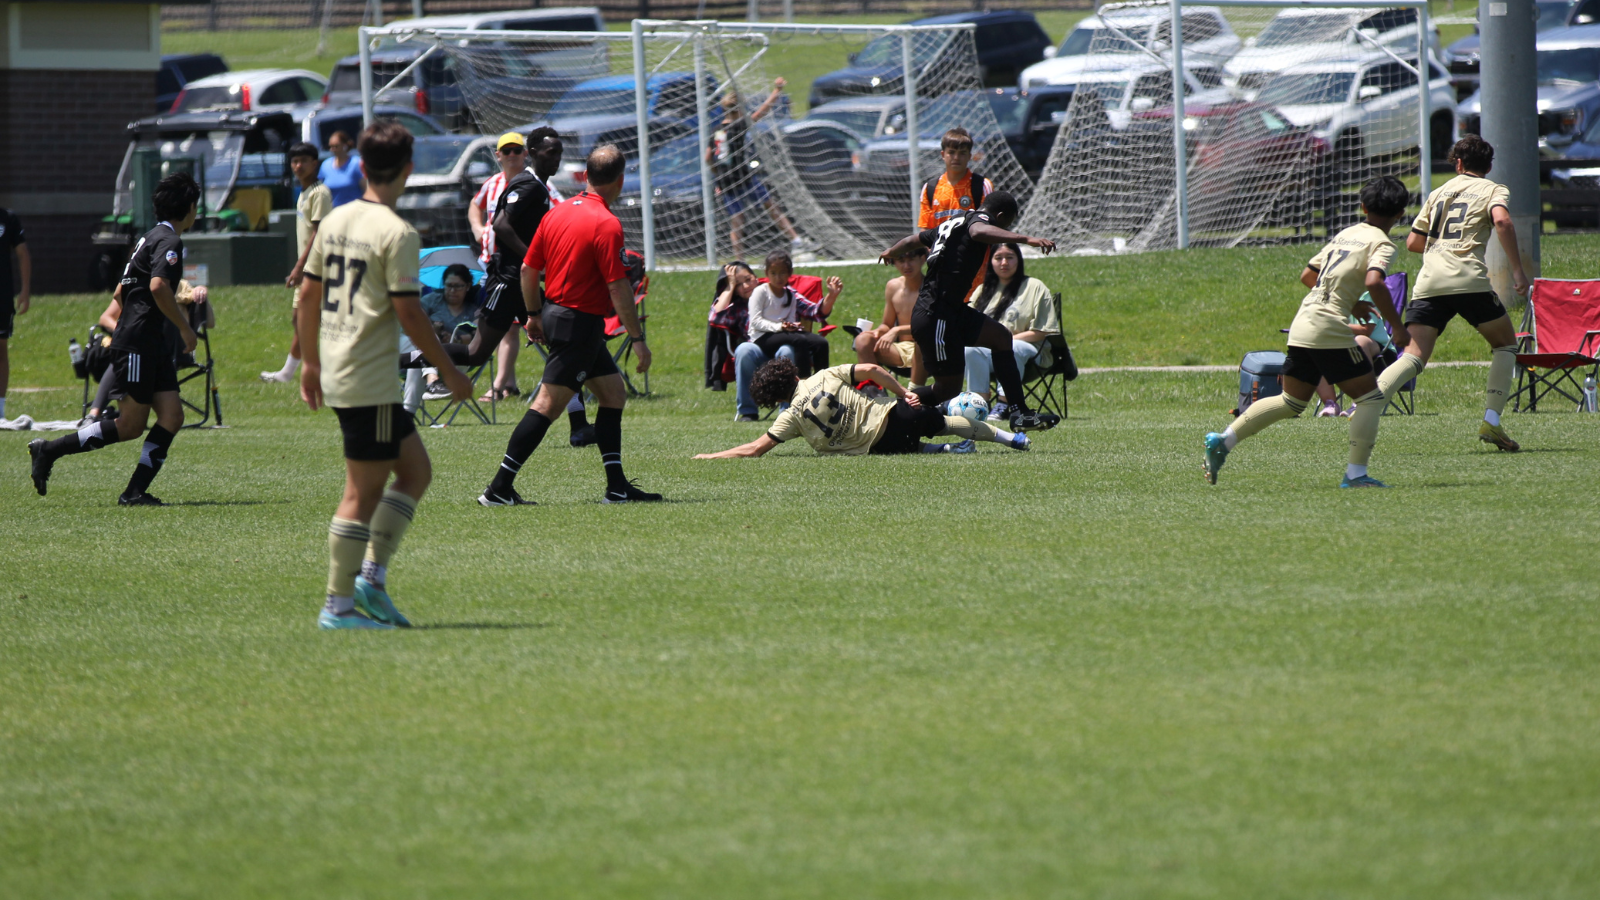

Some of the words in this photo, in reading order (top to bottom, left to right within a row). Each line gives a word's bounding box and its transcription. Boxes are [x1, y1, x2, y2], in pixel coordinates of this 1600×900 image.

[1461, 191, 1479, 200] Farm
[1427, 200, 1469, 240] 12
[323, 253, 367, 315] 27
[1315, 249, 1352, 288] 17
[803, 390, 846, 439] 13
